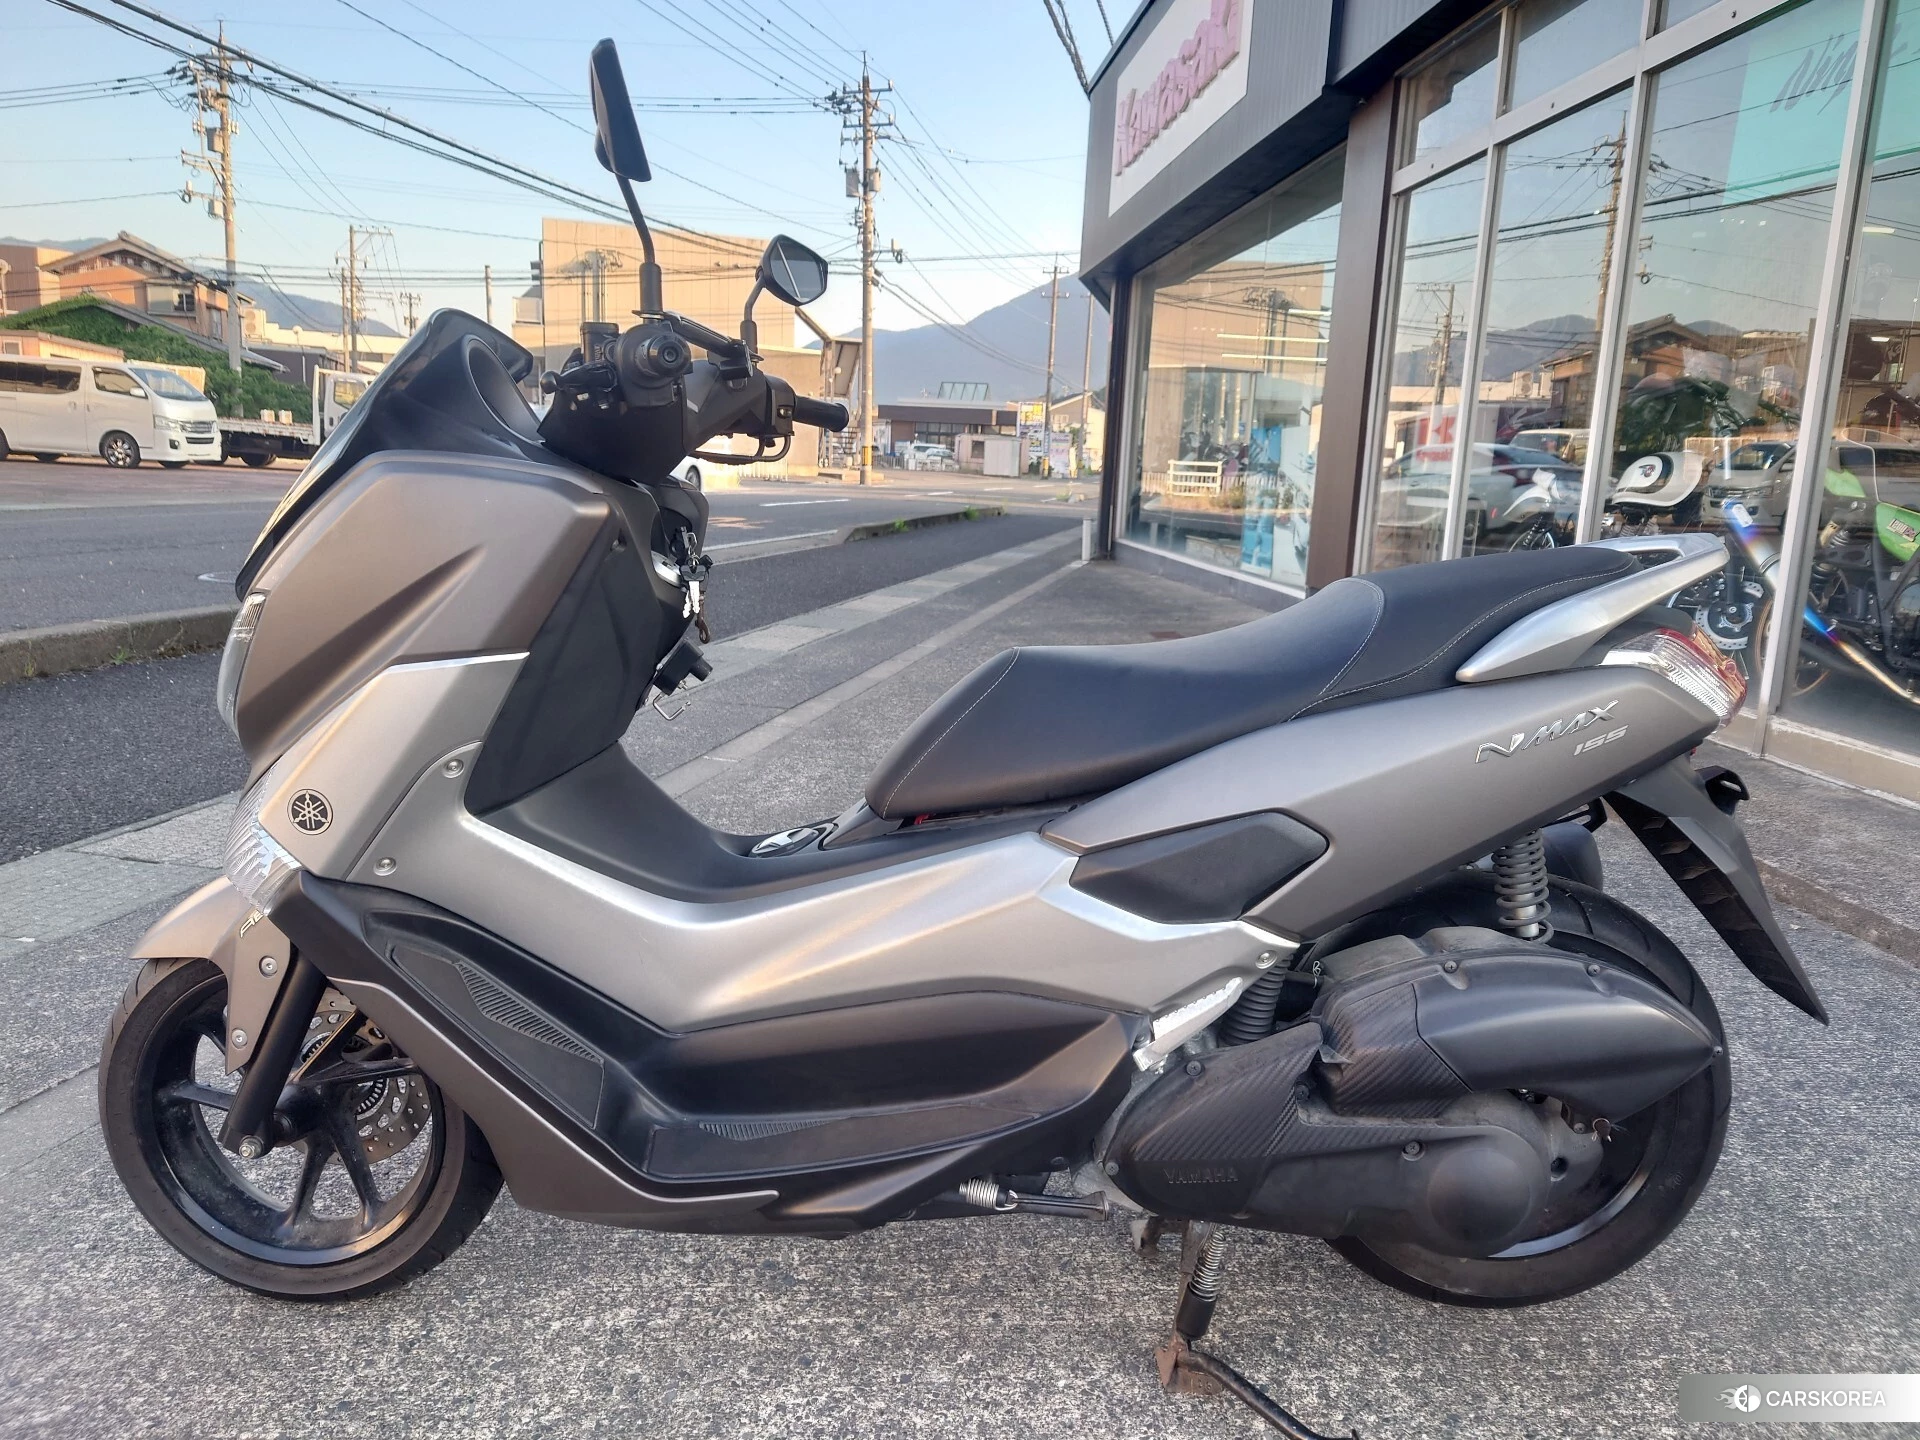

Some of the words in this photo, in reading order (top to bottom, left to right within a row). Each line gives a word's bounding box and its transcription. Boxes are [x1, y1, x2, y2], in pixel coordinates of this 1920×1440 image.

[1115, 0, 1240, 177] Kawasaki
[1573, 724, 1629, 756] 155
[1163, 1167, 1239, 1184] YAMAHA
